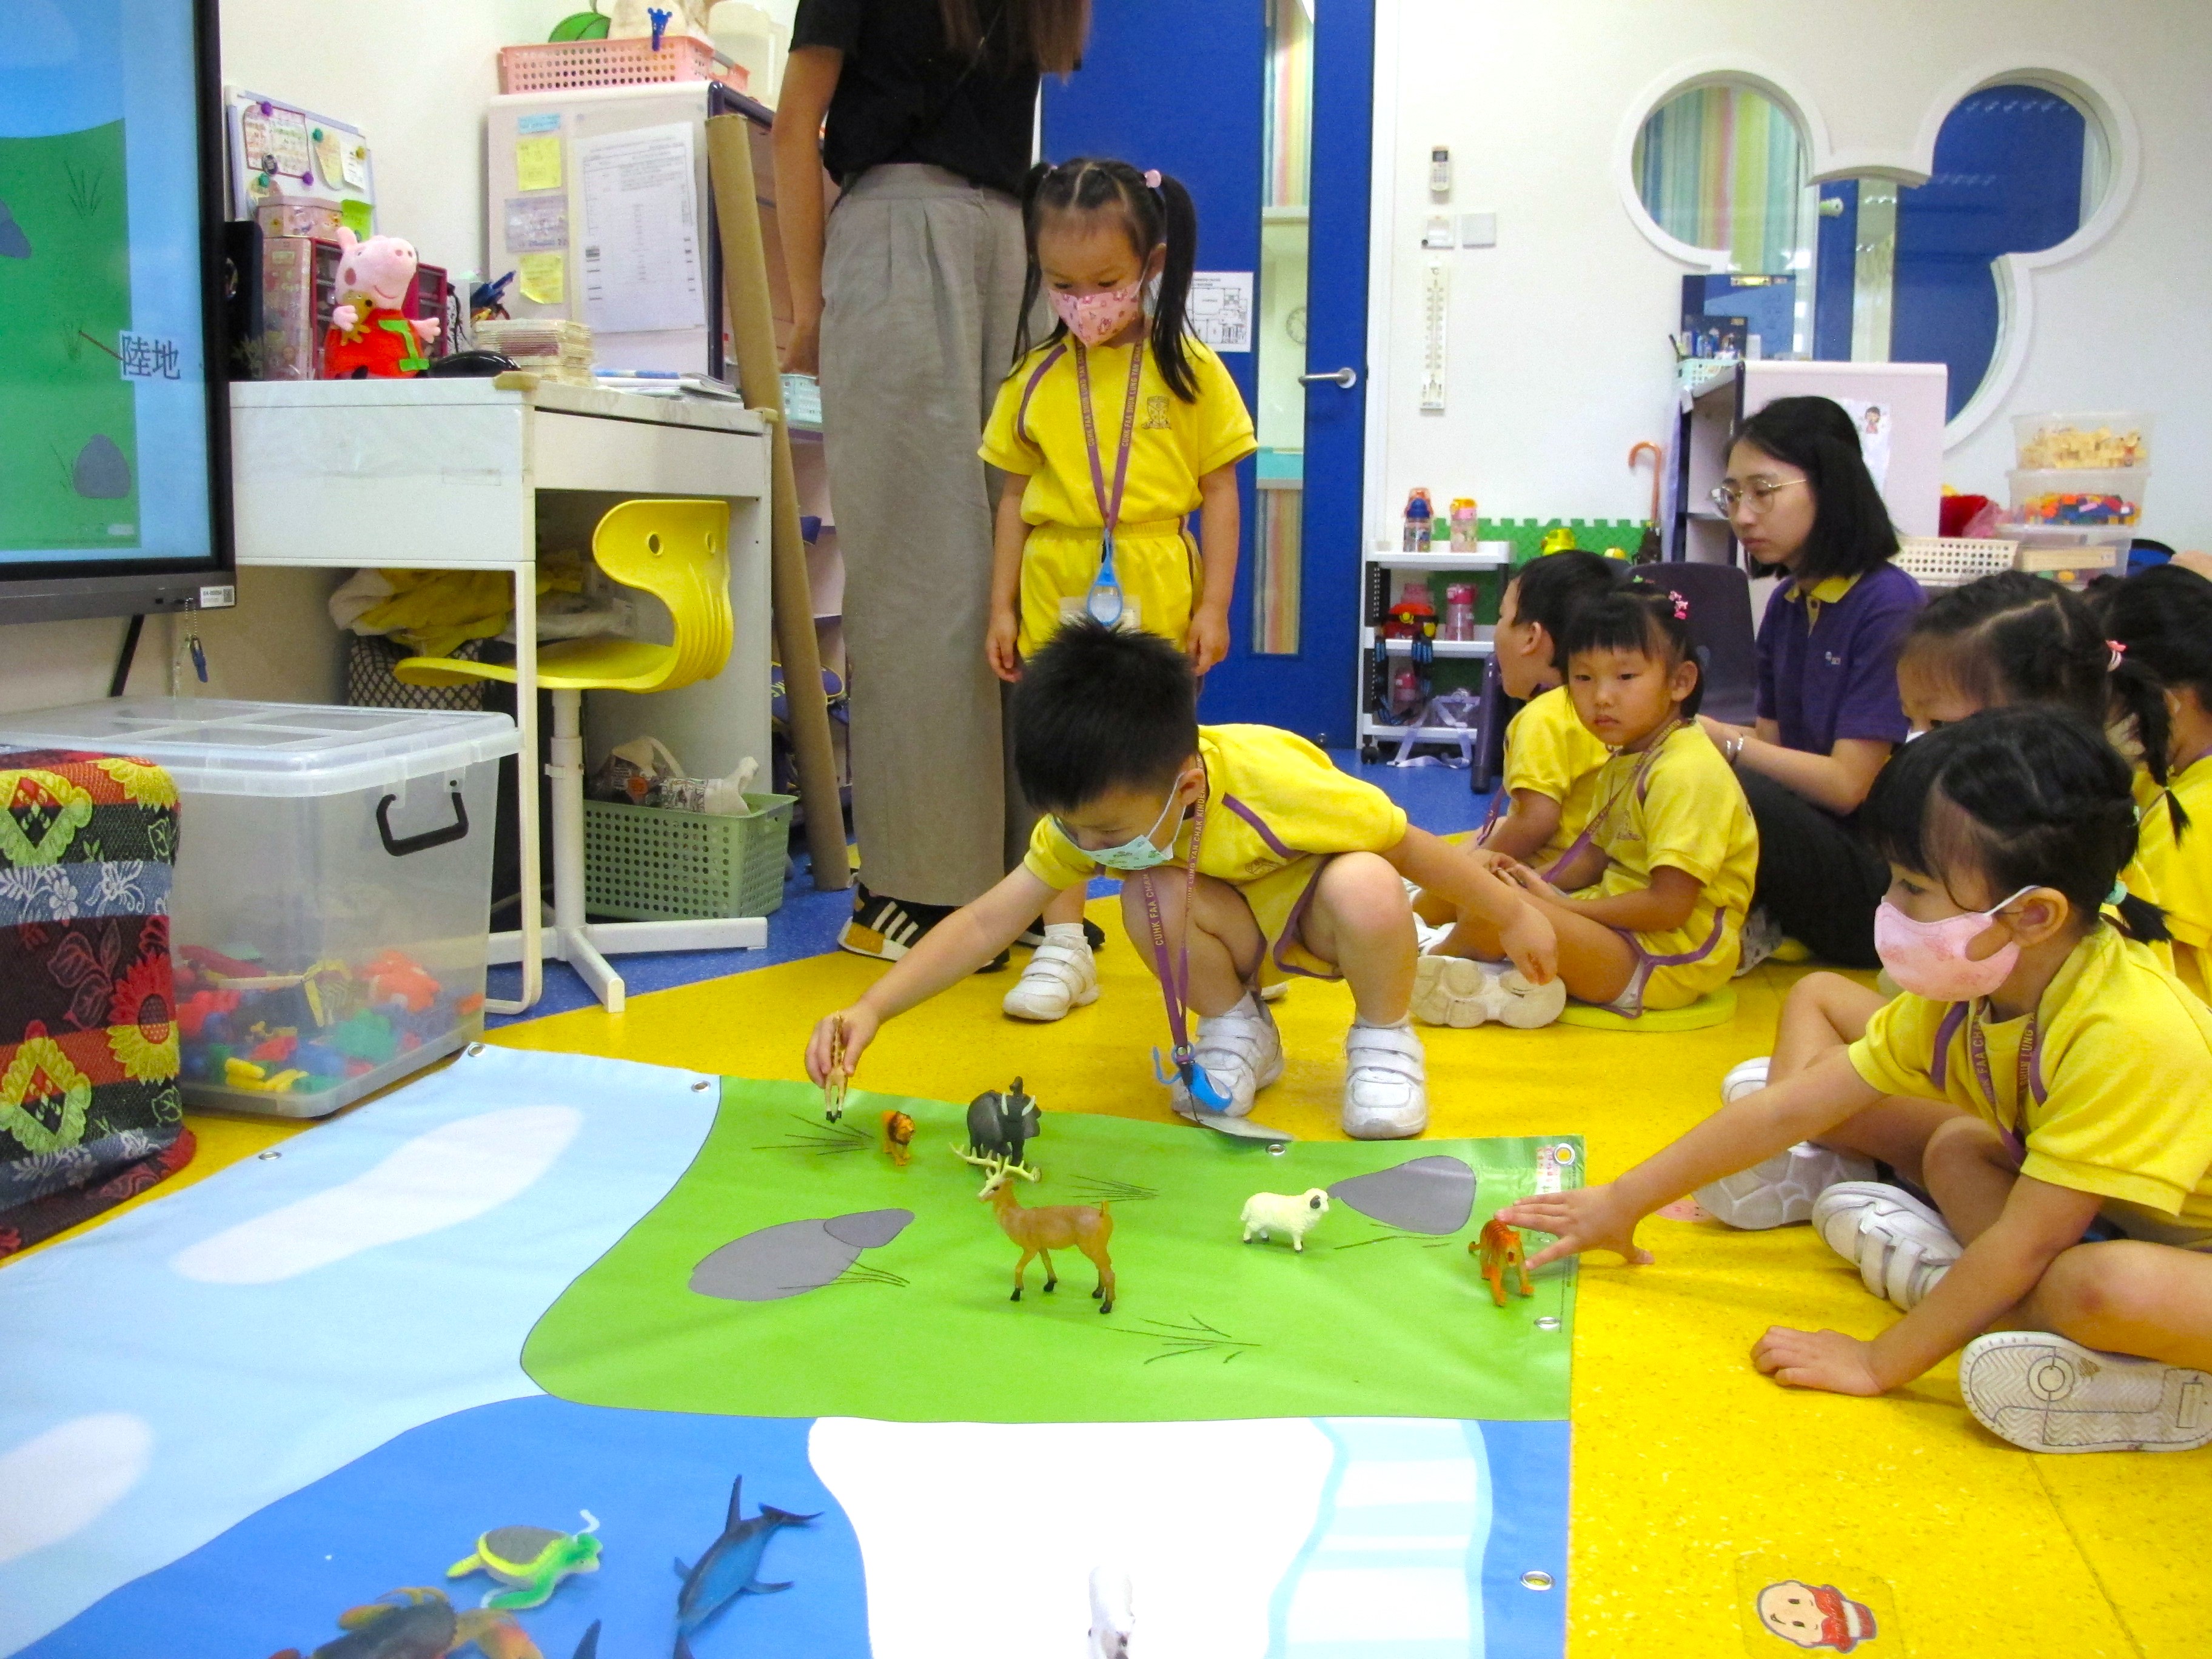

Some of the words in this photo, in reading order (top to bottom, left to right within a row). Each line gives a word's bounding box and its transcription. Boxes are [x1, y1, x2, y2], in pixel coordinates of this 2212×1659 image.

[122, 334, 181, 380] 陸地
[1122, 430, 1130, 446] CUHK
[1129, 378, 1138, 394] LUNG
[1194, 820, 1203, 842] CHAK
[1142, 874, 1154, 897] CHAN
[1148, 900, 1159, 918] FAA
[1151, 920, 1164, 946] CUHK
[2021, 1029, 2034, 1057] LUNG
[1975, 1053, 1988, 1073] FAA
